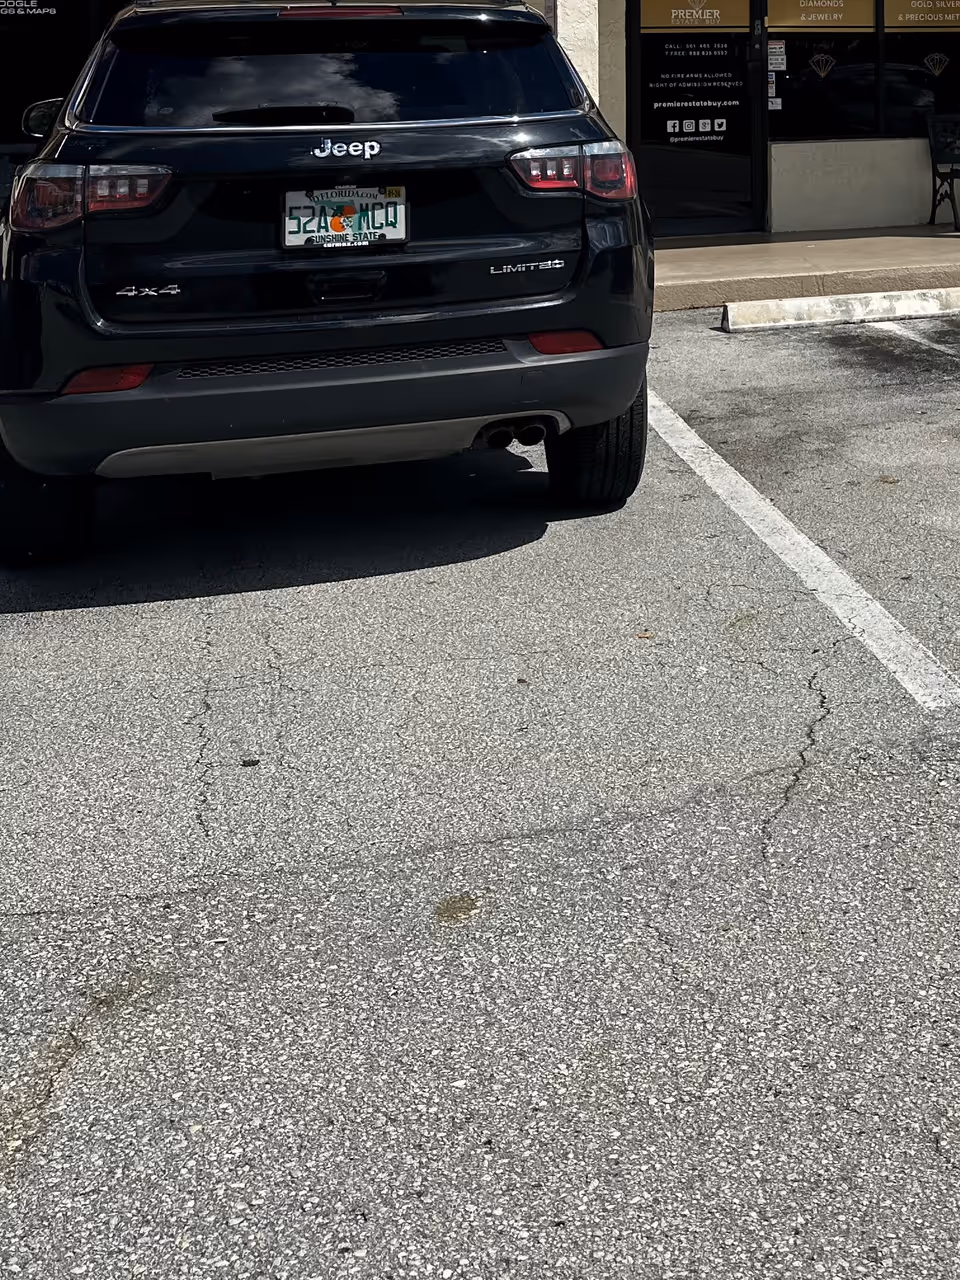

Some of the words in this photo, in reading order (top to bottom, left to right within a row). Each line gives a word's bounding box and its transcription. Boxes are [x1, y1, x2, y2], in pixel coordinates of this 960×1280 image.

[799, 0, 844, 8] DIAMONDS
[936, 0, 960, 8] SILVER
[671, 9, 720, 19] PREMIER
[800, 13, 806, 21] &
[808, 13, 843, 21] JEWELRY
[905, 13, 944, 21] PRECIOUS
[313, 138, 380, 159] Jeep
[288, 205, 330, 234] 52A
[357, 201, 398, 229] MCQ
[310, 232, 350, 244] SUNSHINE
[352, 231, 379, 241] STATE
[323, 240, 369, 248] carmax.com
[489, 259, 565, 274] LIMITED
[115, 284, 181, 296] 4x4
